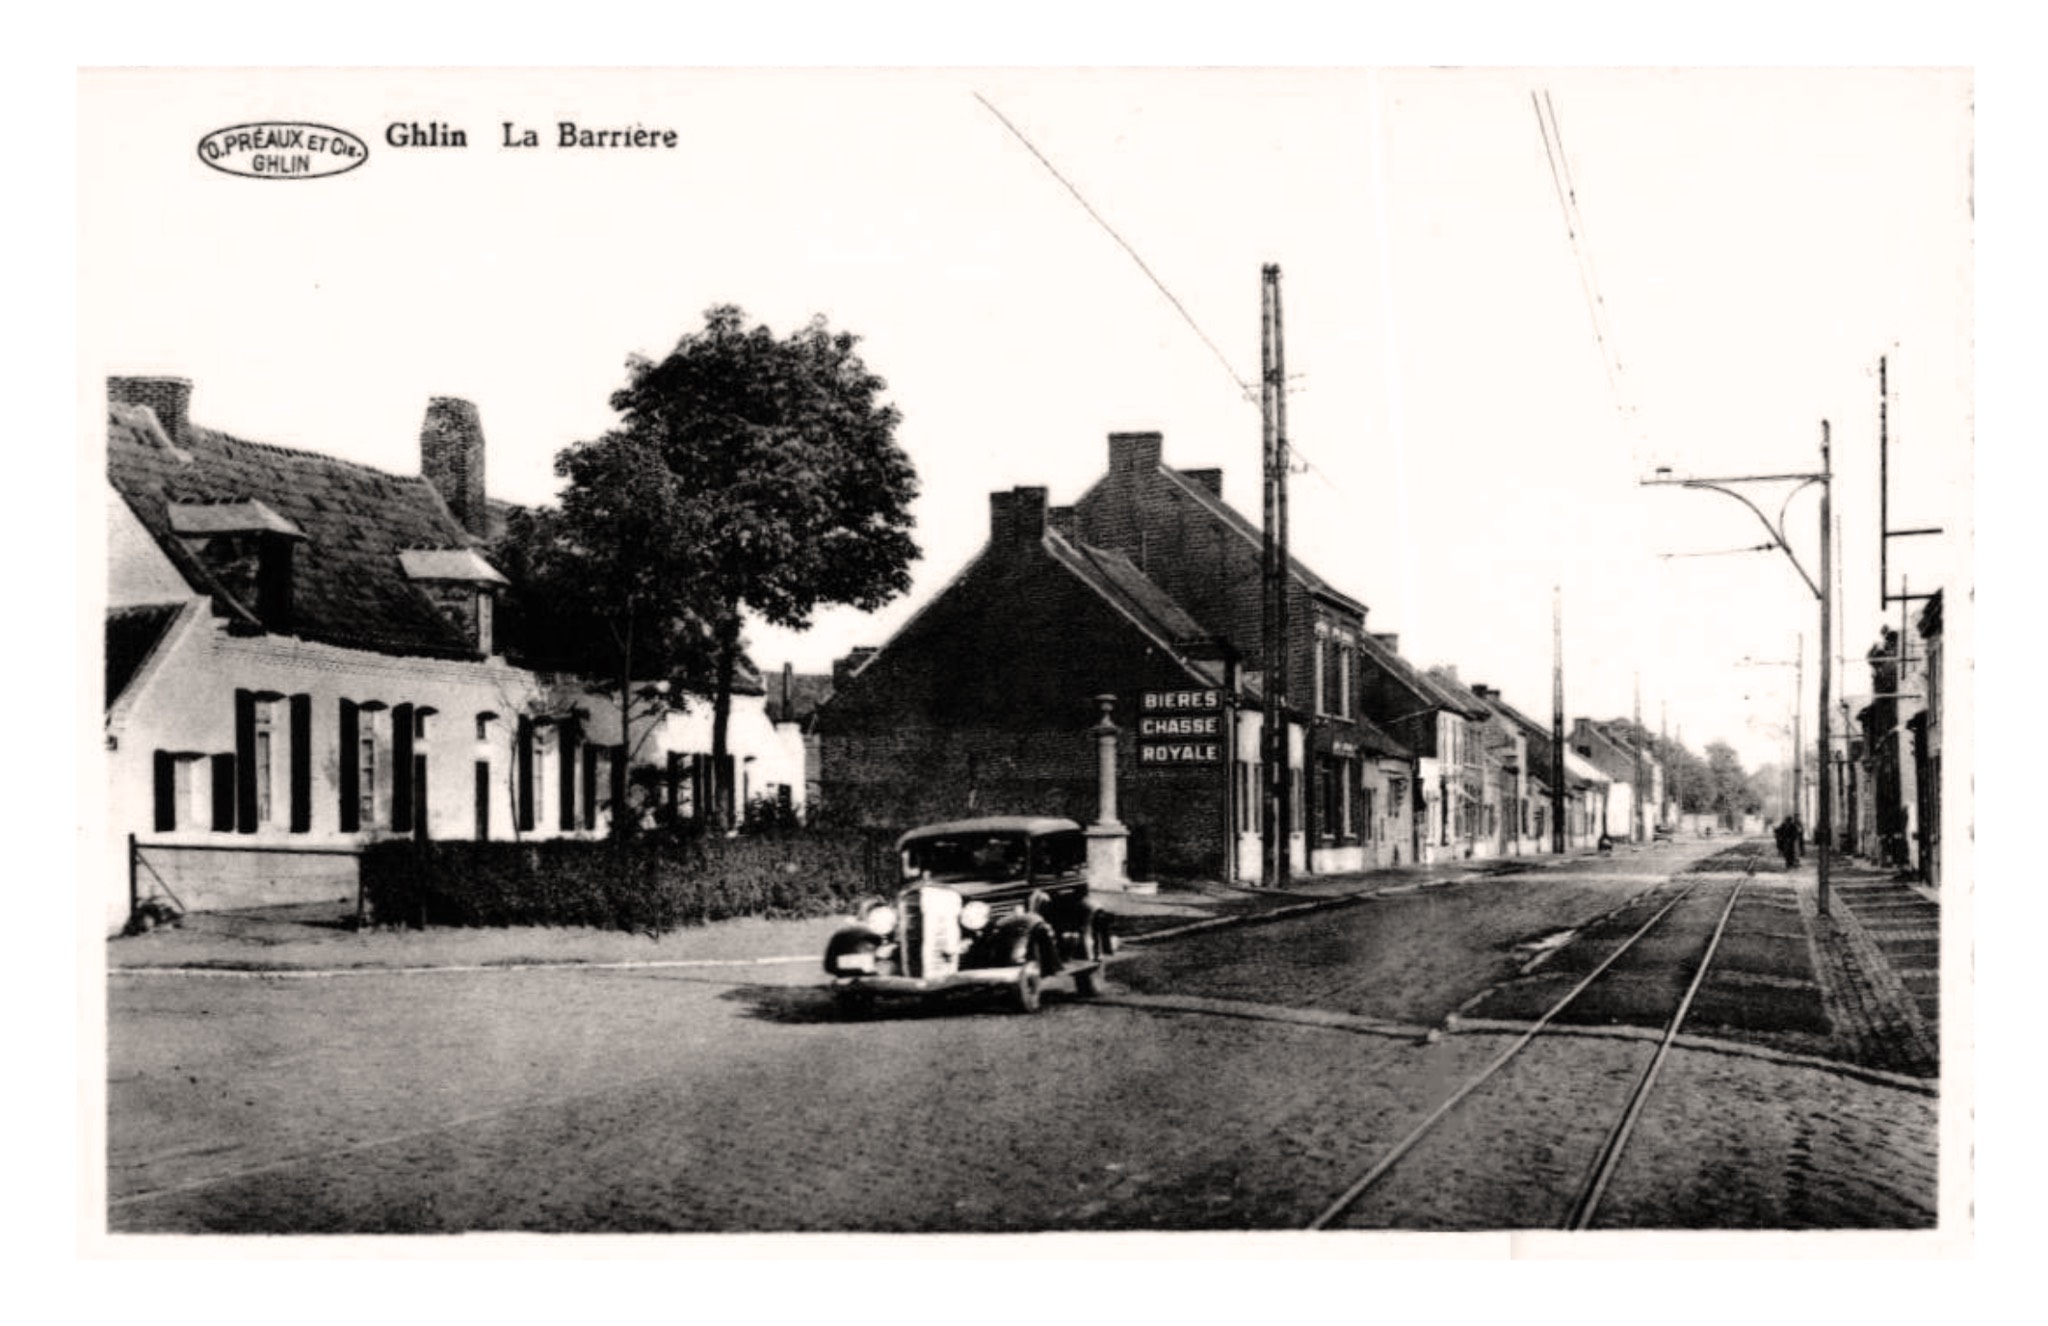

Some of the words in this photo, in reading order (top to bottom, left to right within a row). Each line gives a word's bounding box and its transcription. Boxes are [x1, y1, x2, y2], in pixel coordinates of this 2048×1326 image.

[1146, 691, 1217, 708] BIERES
[1143, 718, 1217, 734] CHASSE
[1143, 745, 1217, 761] ROYALE
